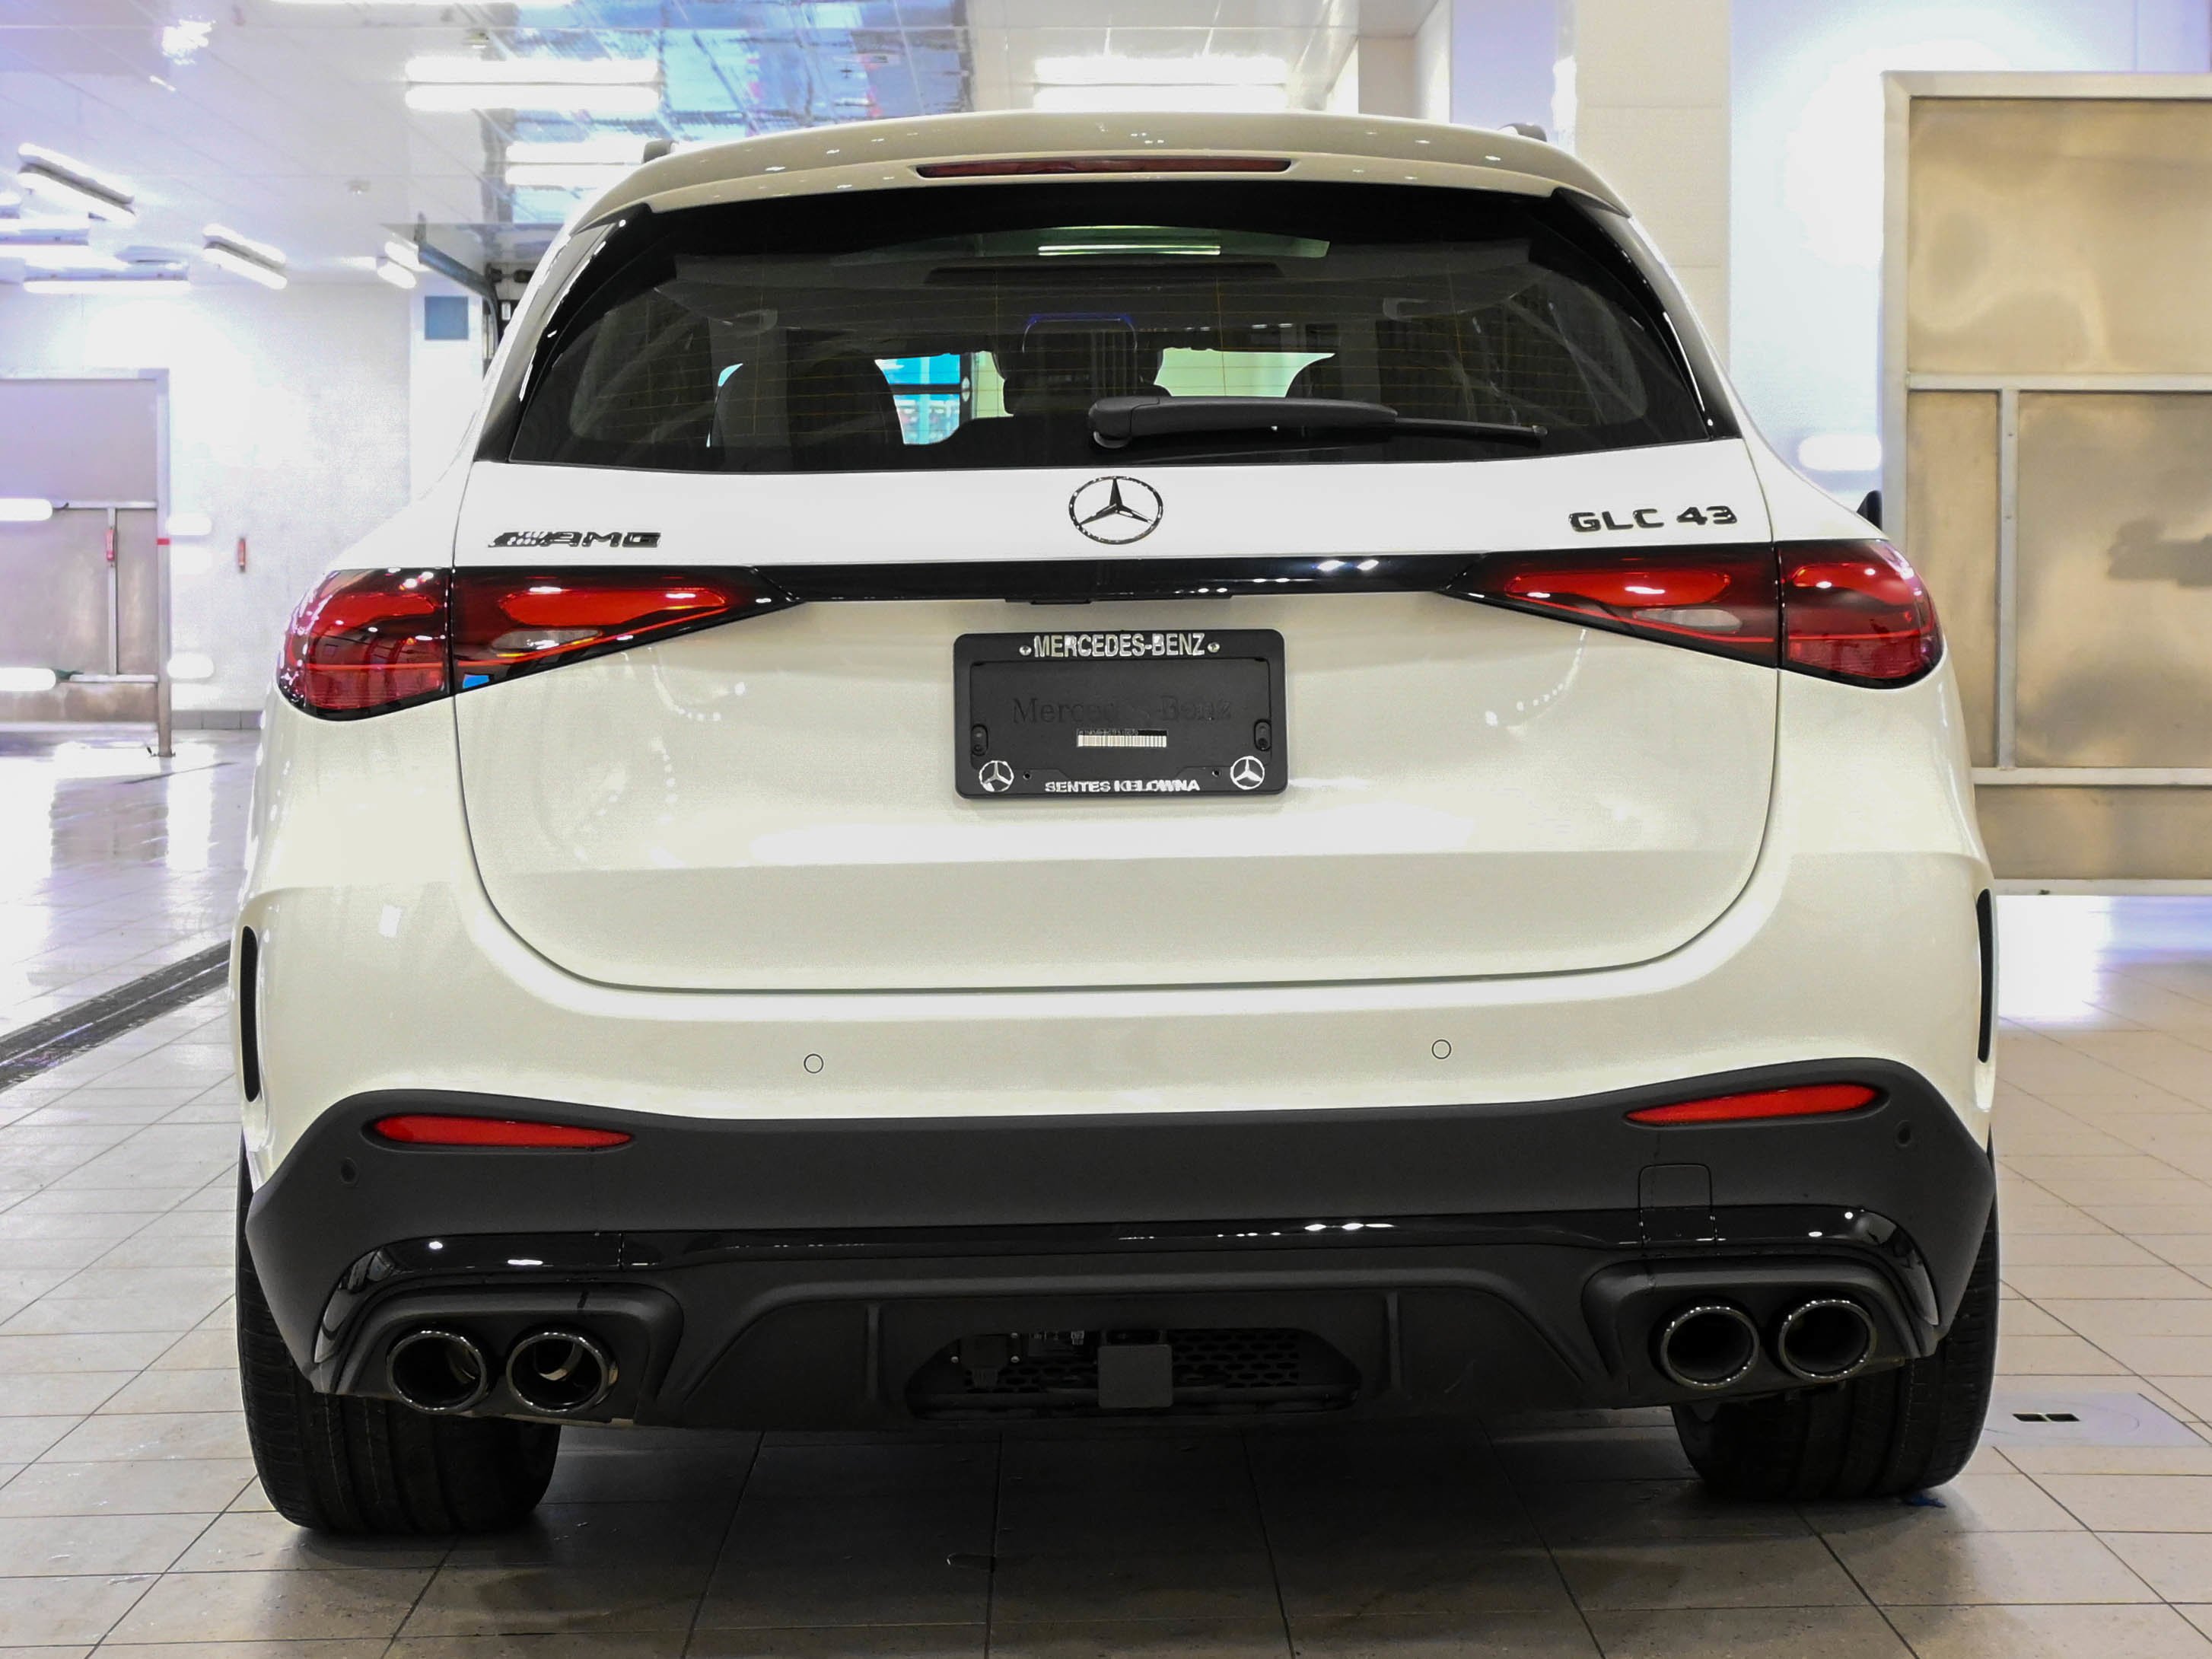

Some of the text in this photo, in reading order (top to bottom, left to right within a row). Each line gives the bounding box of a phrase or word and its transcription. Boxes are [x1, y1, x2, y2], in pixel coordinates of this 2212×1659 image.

[1569, 505, 1738, 532] GLC 43
[537, 531, 661, 548] AMG
[1034, 633, 1205, 657] MERCEDES-BENZ
[1013, 696, 1233, 724] Merceds-Benz
[1045, 780, 1201, 792] SENTES KELOWNA
